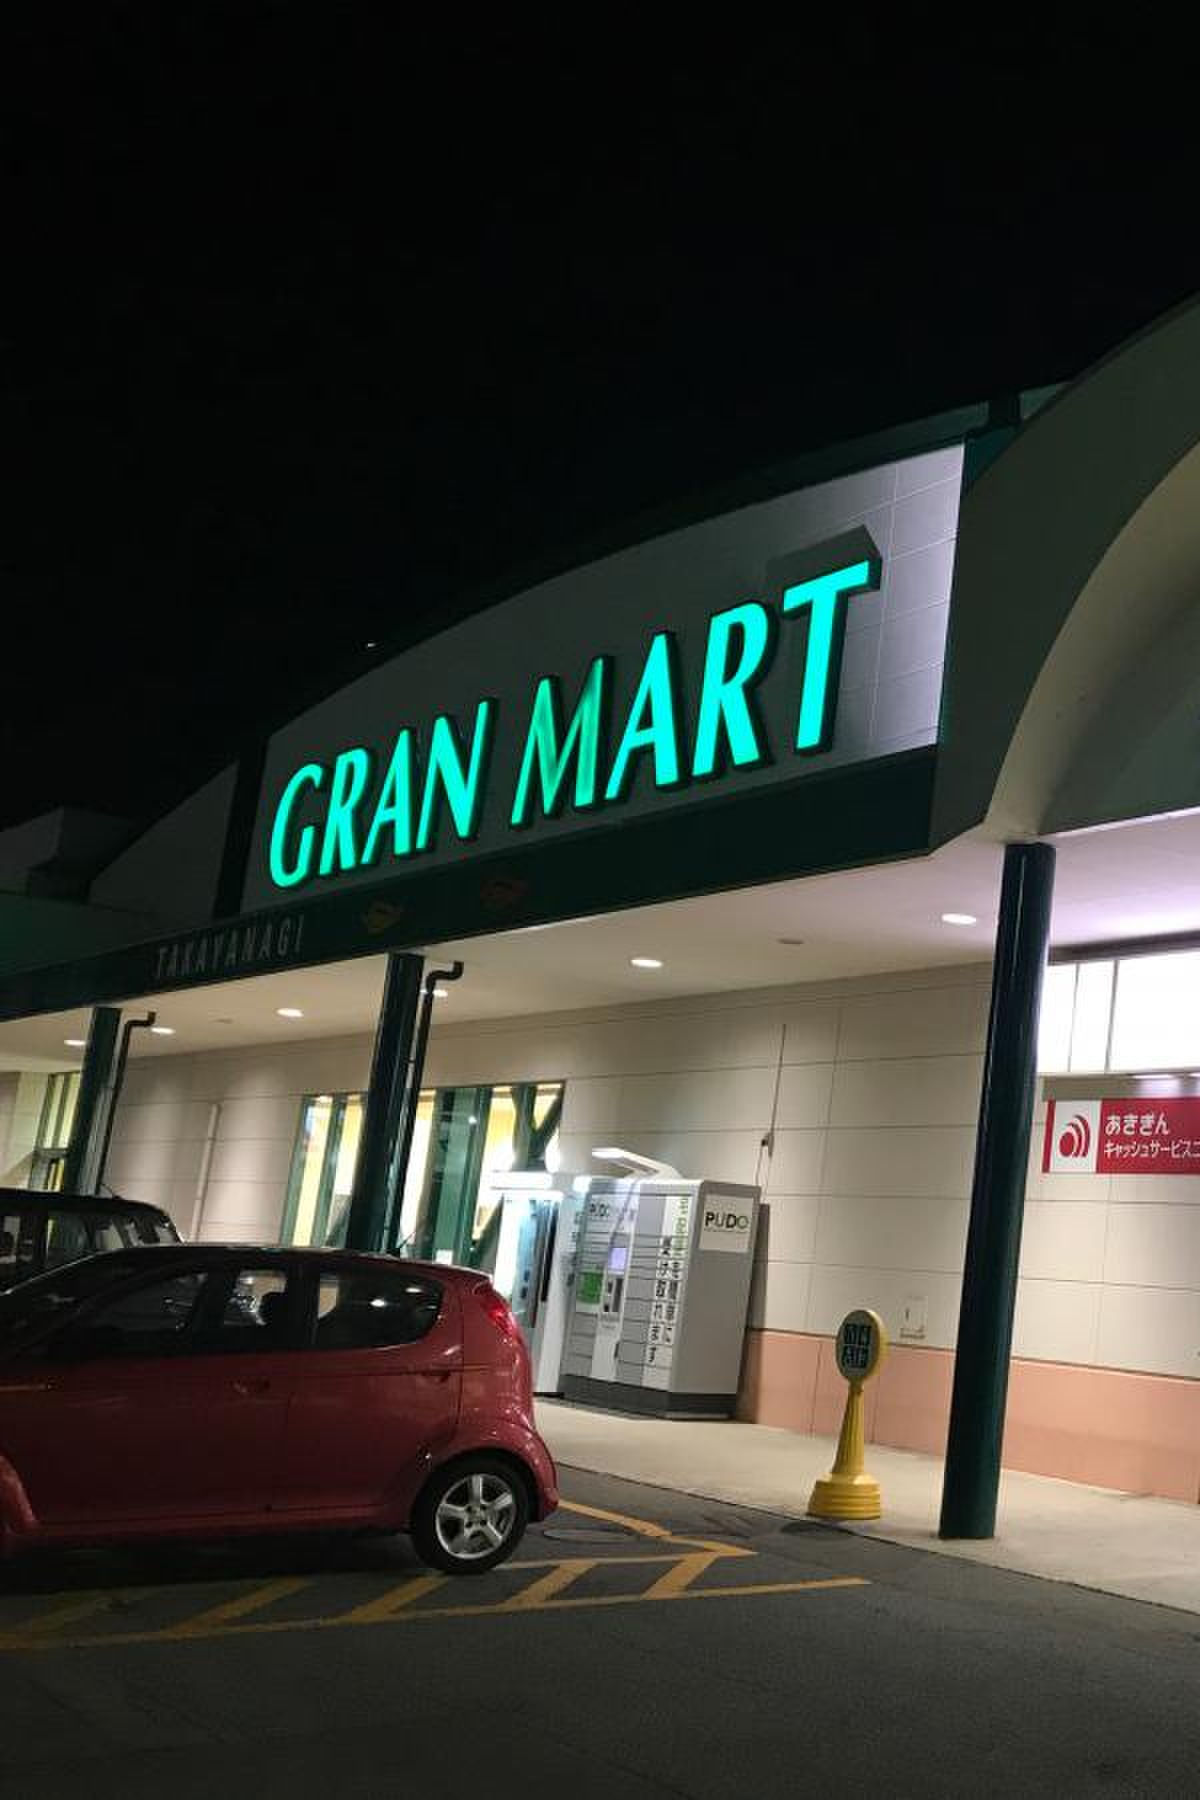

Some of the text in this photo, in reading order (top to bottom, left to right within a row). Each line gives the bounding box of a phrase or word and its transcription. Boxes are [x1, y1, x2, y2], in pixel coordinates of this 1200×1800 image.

[268, 559, 872, 888] GRAN MART
[1104, 1112, 1171, 1136] あきぎん
[705, 1211, 749, 1230] PUDO
